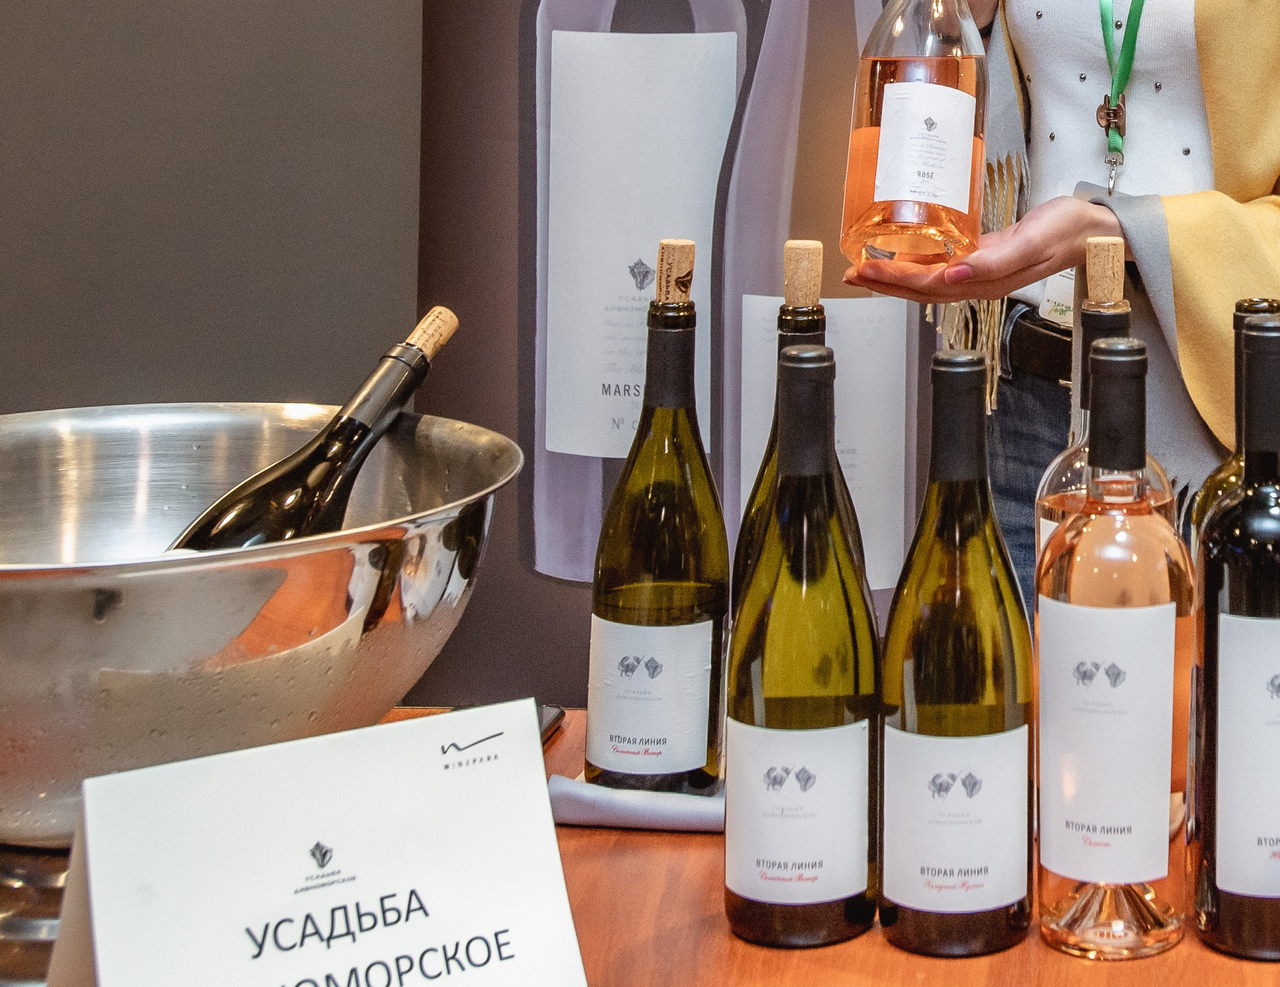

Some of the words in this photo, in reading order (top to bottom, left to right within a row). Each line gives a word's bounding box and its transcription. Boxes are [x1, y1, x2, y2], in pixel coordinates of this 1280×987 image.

[917, 170, 934, 179] ROSÉ
[602, 383, 642, 397] MARS
[609, 734, 637, 745] ВТОРАЯ
[639, 737, 667, 746] ЛИНИЯ
[1065, 820, 1097, 834] ВТОРАЯ
[1100, 825, 1132, 835] ЛИНИЯ
[756, 858, 789, 871] ВТОРАЯ
[791, 860, 823, 871] ЛИНИЯ
[920, 866, 955, 878] ВТОРАЯ
[957, 866, 989, 878] ЛИНИЯ
[245, 888, 430, 959] УСАДЬБА
[281, 929, 515, 987] МОРСКОЕ
